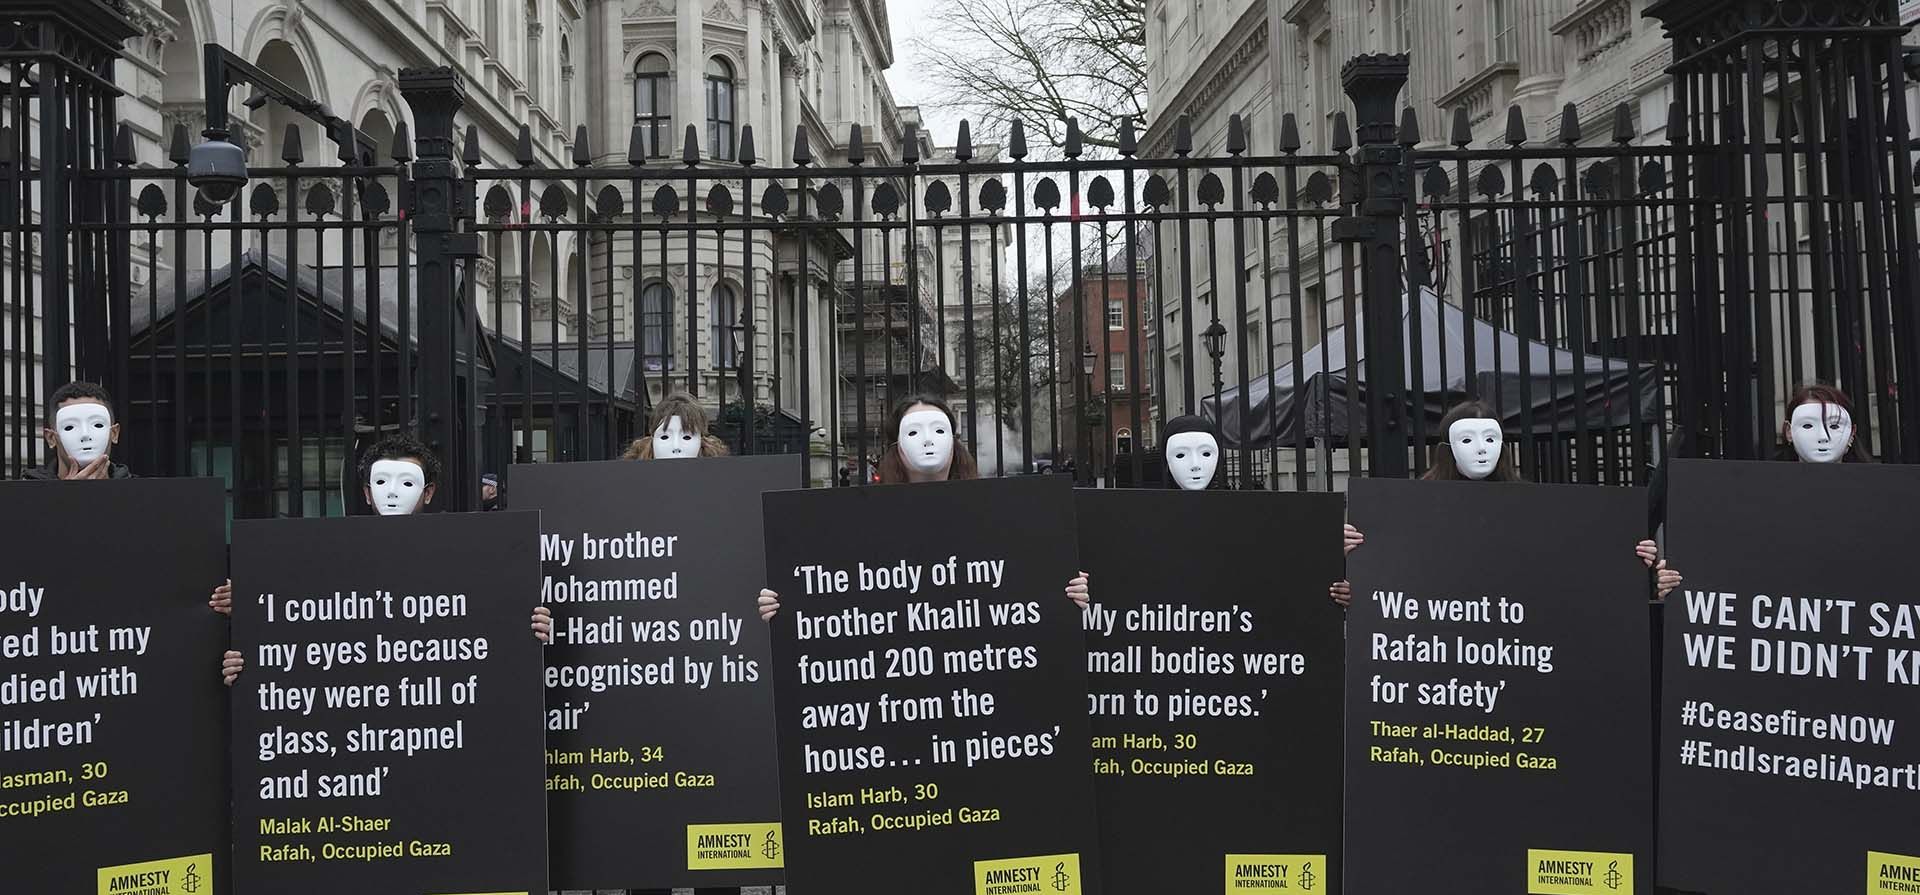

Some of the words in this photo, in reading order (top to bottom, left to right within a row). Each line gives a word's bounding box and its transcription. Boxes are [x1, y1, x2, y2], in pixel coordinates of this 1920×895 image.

[583, 531, 677, 560] brother
[794, 565, 848, 594] ‘The
[859, 560, 922, 593] body
[932, 556, 956, 585] of
[967, 560, 1004, 588] my
[286, 590, 393, 621] couldn’t
[403, 594, 466, 623] open
[797, 607, 897, 639] brother
[907, 599, 980, 632] Khalil
[989, 602, 1040, 626] was
[1126, 604, 1252, 632] children’s
[1373, 591, 1418, 619] ‘We
[1428, 597, 1490, 622] went
[1499, 597, 1523, 623] to
[1684, 590, 1736, 626] WE
[1752, 595, 1855, 634] CAN’T
[0, 627, 38, 658] ed
[51, 625, 98, 654] but
[110, 627, 151, 655] my
[543, 615, 622, 645] l-Hadi
[631, 620, 680, 642] was
[690, 612, 742, 645] only
[259, 644, 297, 671] my
[307, 642, 366, 670] eyes
[377, 634, 488, 662] because
[798, 650, 875, 684] found
[885, 647, 933, 678] 200
[944, 644, 1037, 673] metres
[1152, 646, 1234, 674] bodies
[1243, 654, 1304, 674] were
[1373, 633, 1446, 662] Rafah
[1457, 636, 1553, 673] looking
[1683, 633, 1735, 669] WE
[1751, 639, 1872, 680] DIDN’T
[1, 671, 65, 704] died
[76, 666, 136, 698] with
[684, 656, 713, 689] by
[722, 654, 758, 682] his
[258, 682, 316, 715] they
[325, 685, 389, 708] were
[399, 677, 441, 706] full
[452, 675, 477, 704] of
[1134, 690, 1158, 715] to
[1169, 689, 1267, 721] pieces.’
[1371, 675, 1409, 703] for
[1418, 678, 1505, 713] safety’
[544, 702, 589, 730] air’
[802, 702, 870, 731] away
[878, 694, 942, 722] from
[951, 688, 994, 717] the
[1681, 701, 1894, 745] #CeasefireNOW
[259, 726, 336, 761] glass,
[347, 720, 462, 756] shrapnel
[933, 735, 956, 763] in
[966, 726, 1060, 767] pieces’
[1124, 734, 1167, 751] Harb,
[1175, 734, 1196, 749] 30
[1370, 721, 1417, 737] Thaer
[1423, 724, 1514, 744] al-Haddad,
[1522, 728, 1544, 743] 27
[591, 748, 634, 765] Harb,
[641, 747, 663, 762] 34
[1132, 759, 1208, 777] Occupied
[1215, 760, 1253, 775] Gaza
[1371, 746, 1424, 766] Rafah,
[1431, 749, 1509, 769] Occupied
[1516, 753, 1556, 769] Gaza
[1680, 740, 1920, 790] #EndIsraeliApart
[0, 770, 72, 788] asman,
[81, 762, 107, 779] 30
[260, 769, 307, 799] and
[318, 767, 388, 797] sand’
[592, 772, 668, 791] Occupied
[675, 772, 714, 787] Gaza
[83, 791, 128, 806] Gaza
[808, 792, 853, 808] Islam
[861, 786, 907, 804] Harb,
[915, 783, 938, 800] 30
[261, 818, 311, 834] Malak
[317, 816, 390, 832] Al-Shaer
[809, 817, 864, 835] Rafah,
[872, 811, 952, 830] Occupied
[959, 808, 999, 823] Gaza
[261, 845, 315, 862] Rafah,
[323, 842, 402, 861] Occupied
[410, 841, 450, 856] Gaza
[698, 834, 751, 848] AMNESTY
[698, 850, 751, 859] INTERNATIONAL
[109, 869, 170, 891] AMNESTY
[986, 867, 1040, 884] AMNESTY
[1235, 864, 1288, 878] AMNESTY
[1538, 860, 1593, 875] AMNESTY
[1538, 876, 1593, 886] INTERNATIONAL
[110, 887, 170, 895] RNATIONAL
[986, 883, 1040, 895] INTERNATIONAL
[1235, 879, 1288, 889] INTERNATIONAL
